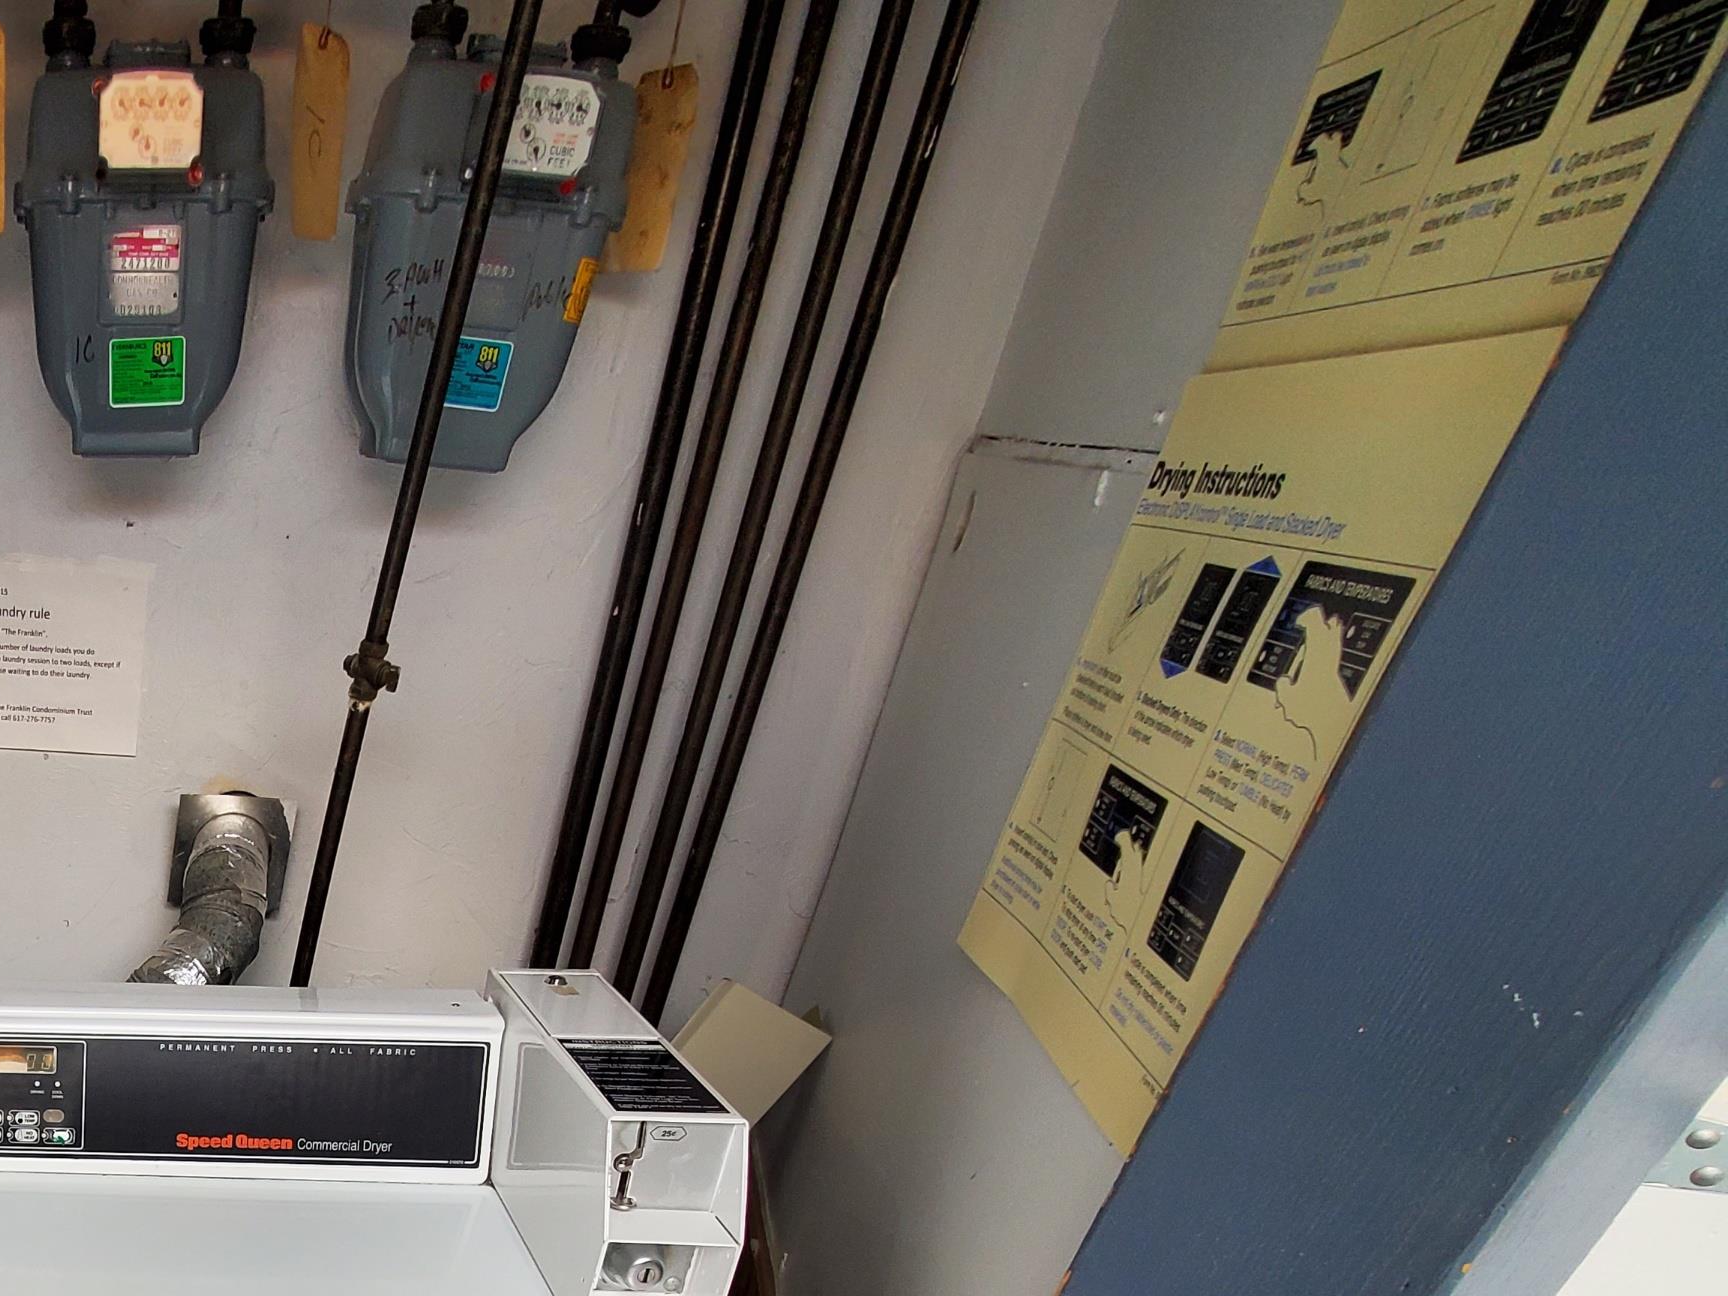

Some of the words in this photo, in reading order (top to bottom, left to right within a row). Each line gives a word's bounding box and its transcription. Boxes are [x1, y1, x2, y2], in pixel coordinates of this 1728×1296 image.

[549, 145, 575, 157] CUBIC
[154, 342, 171, 357] 811
[480, 346, 499, 361] 811
[1147, 461, 1197, 499] Drying
[1194, 462, 1286, 500] Instructions
[29, 607, 51, 619] rule
[21, 644, 28, 652] of
[30, 644, 53, 654] laundry
[55, 646, 72, 654] loads
[86, 648, 95, 656] do
[2, 655, 26, 665] laundry
[27, 657, 50, 665] session
[73, 659, 92, 668] loads,
[94, 661, 115, 669] except
[8, 668, 31, 677] waiting
[40, 669, 49, 677] do
[50, 669, 65, 678] their
[6, 704, 31, 712] Franklin
[32, 705, 75, 715] Condominium
[77, 708, 92, 716] Trust
[1, 713, 11, 721] call
[160, 1043, 237, 1051] PERMANENT
[330, 1047, 354, 1055] ALL
[370, 1048, 417, 1056] FABRIC
[176, 1133, 233, 1152] Speed
[235, 1134, 293, 1150] Queen
[297, 1138, 360, 1152] Commercial
[362, 1140, 393, 1153] Dryer
